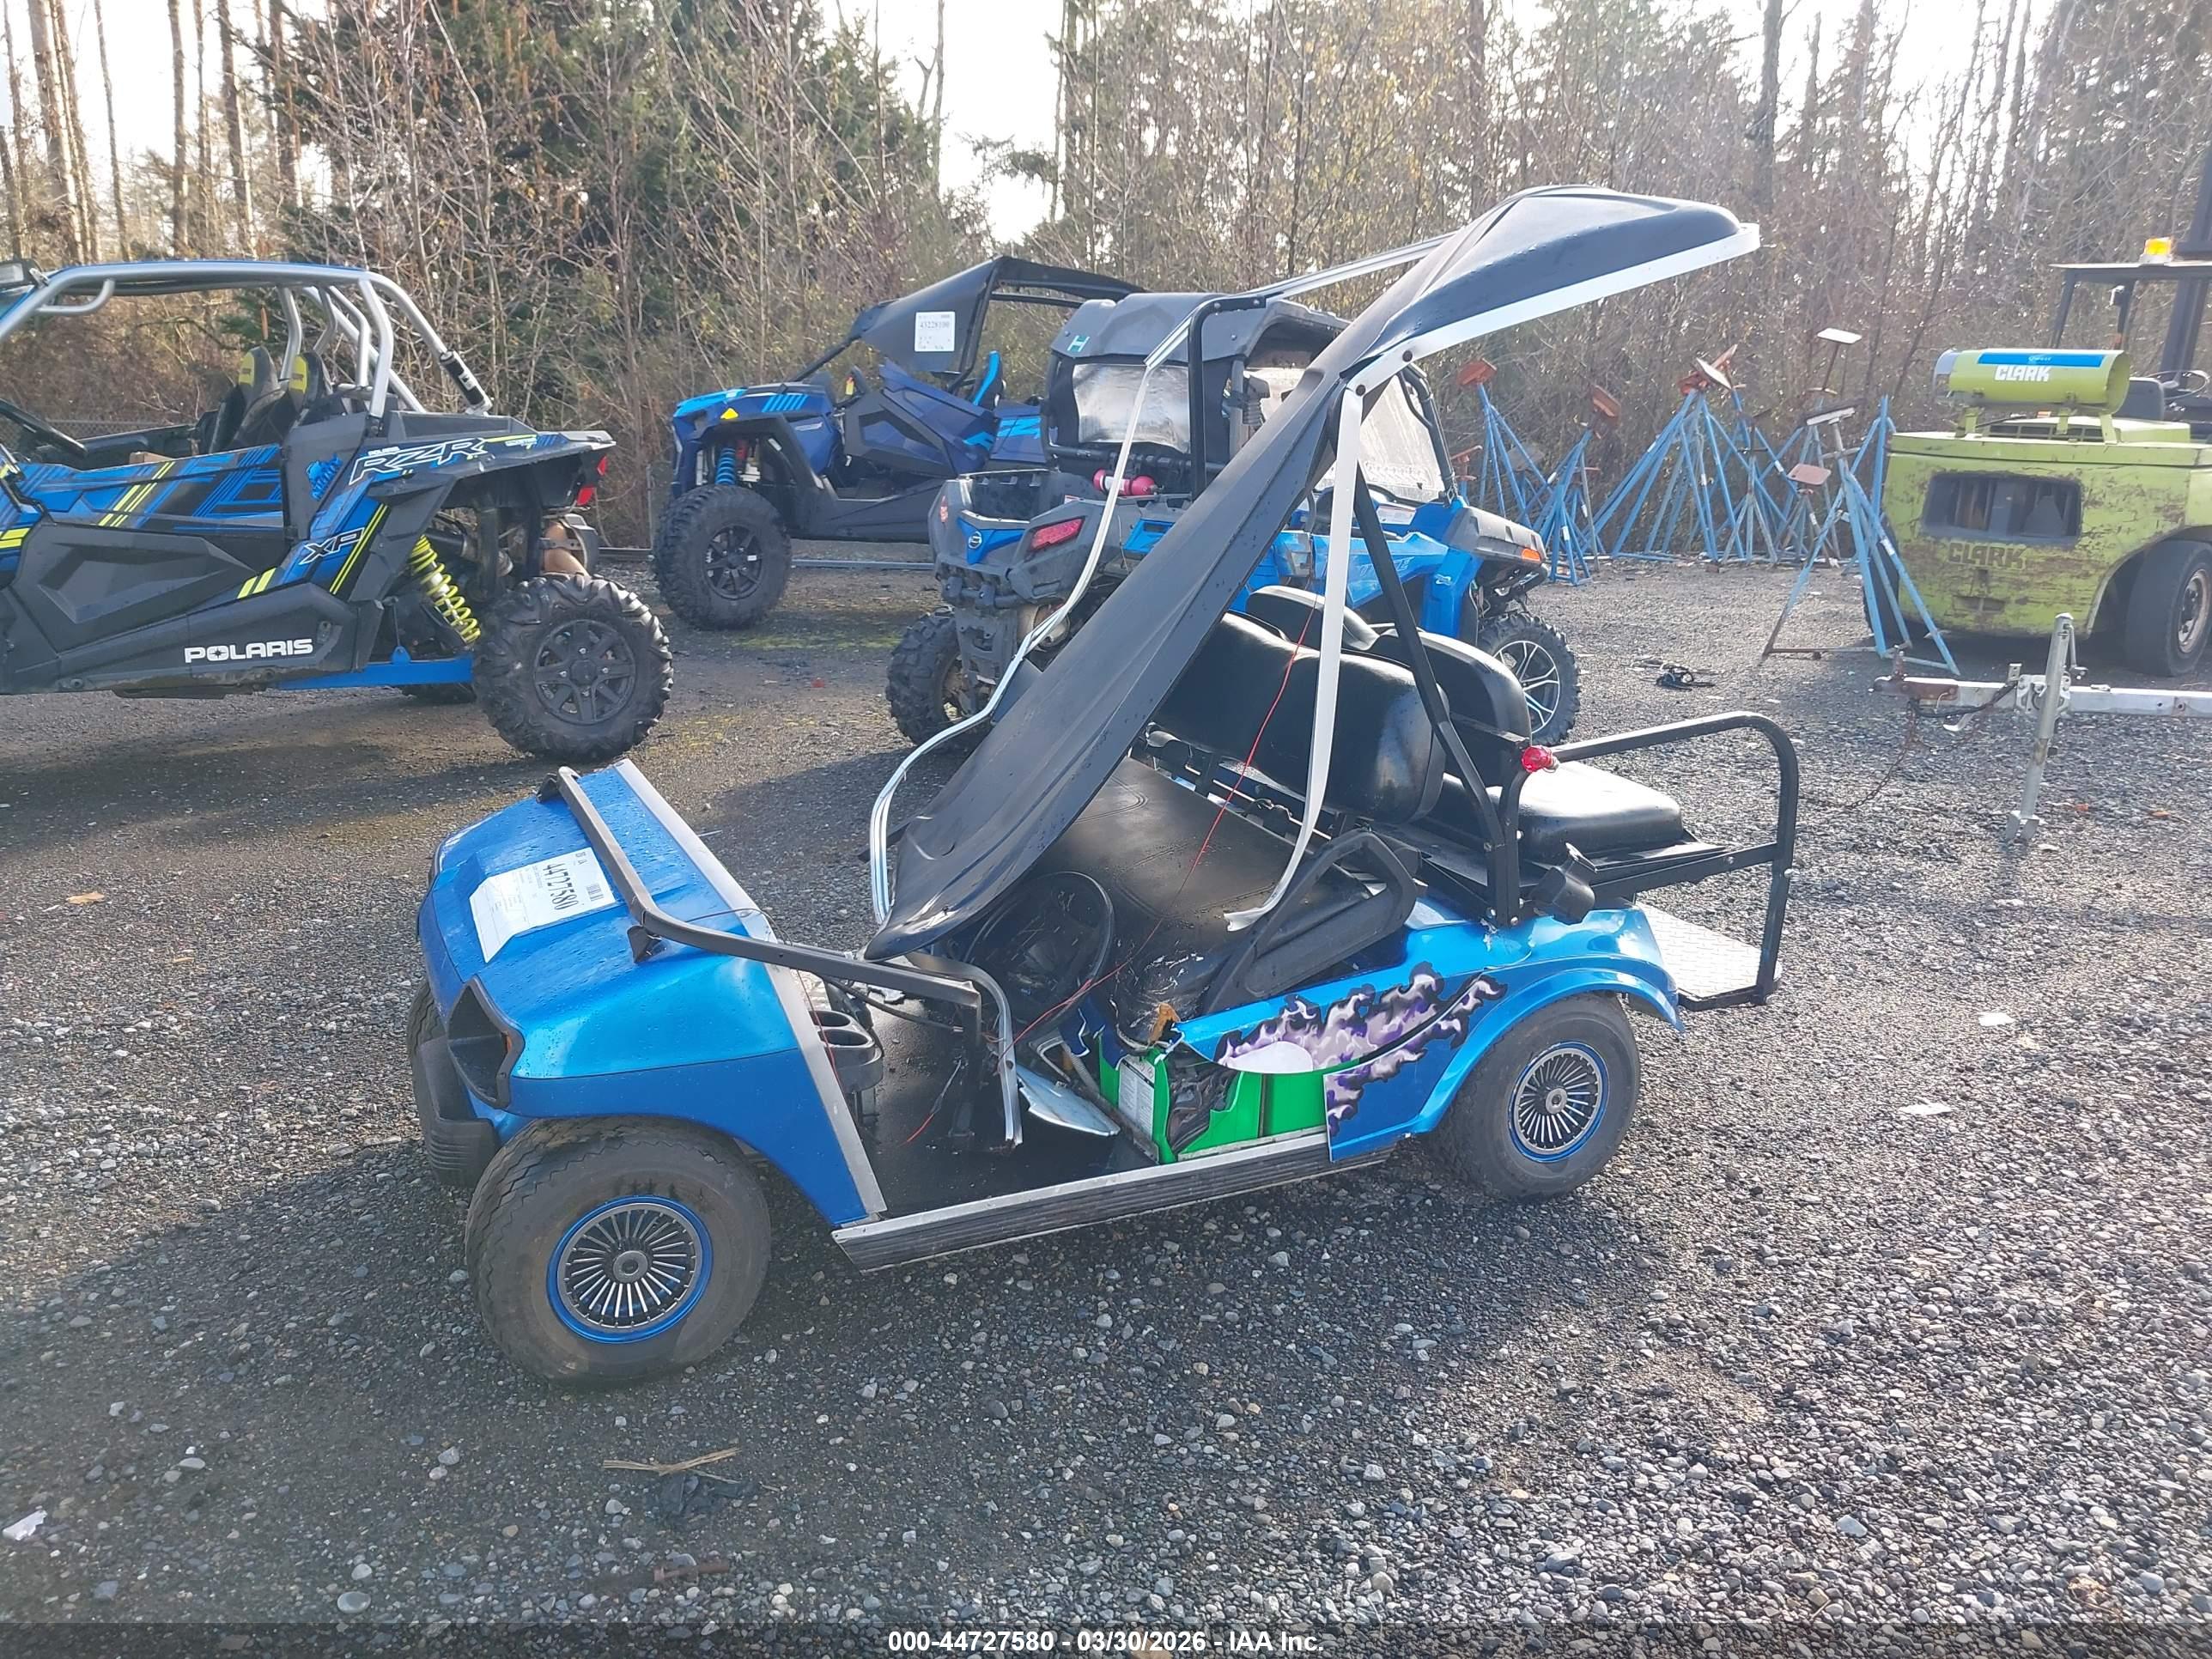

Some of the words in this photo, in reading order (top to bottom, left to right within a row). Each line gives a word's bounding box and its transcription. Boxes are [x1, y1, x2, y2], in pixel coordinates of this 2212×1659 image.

[1995, 365, 2051, 381] CLARK
[349, 438, 488, 486] RZR
[298, 527, 365, 565] XP
[1948, 541, 2027, 568] CLARK
[184, 638, 313, 664] POLARIS
[542, 863, 580, 910] 44727580
